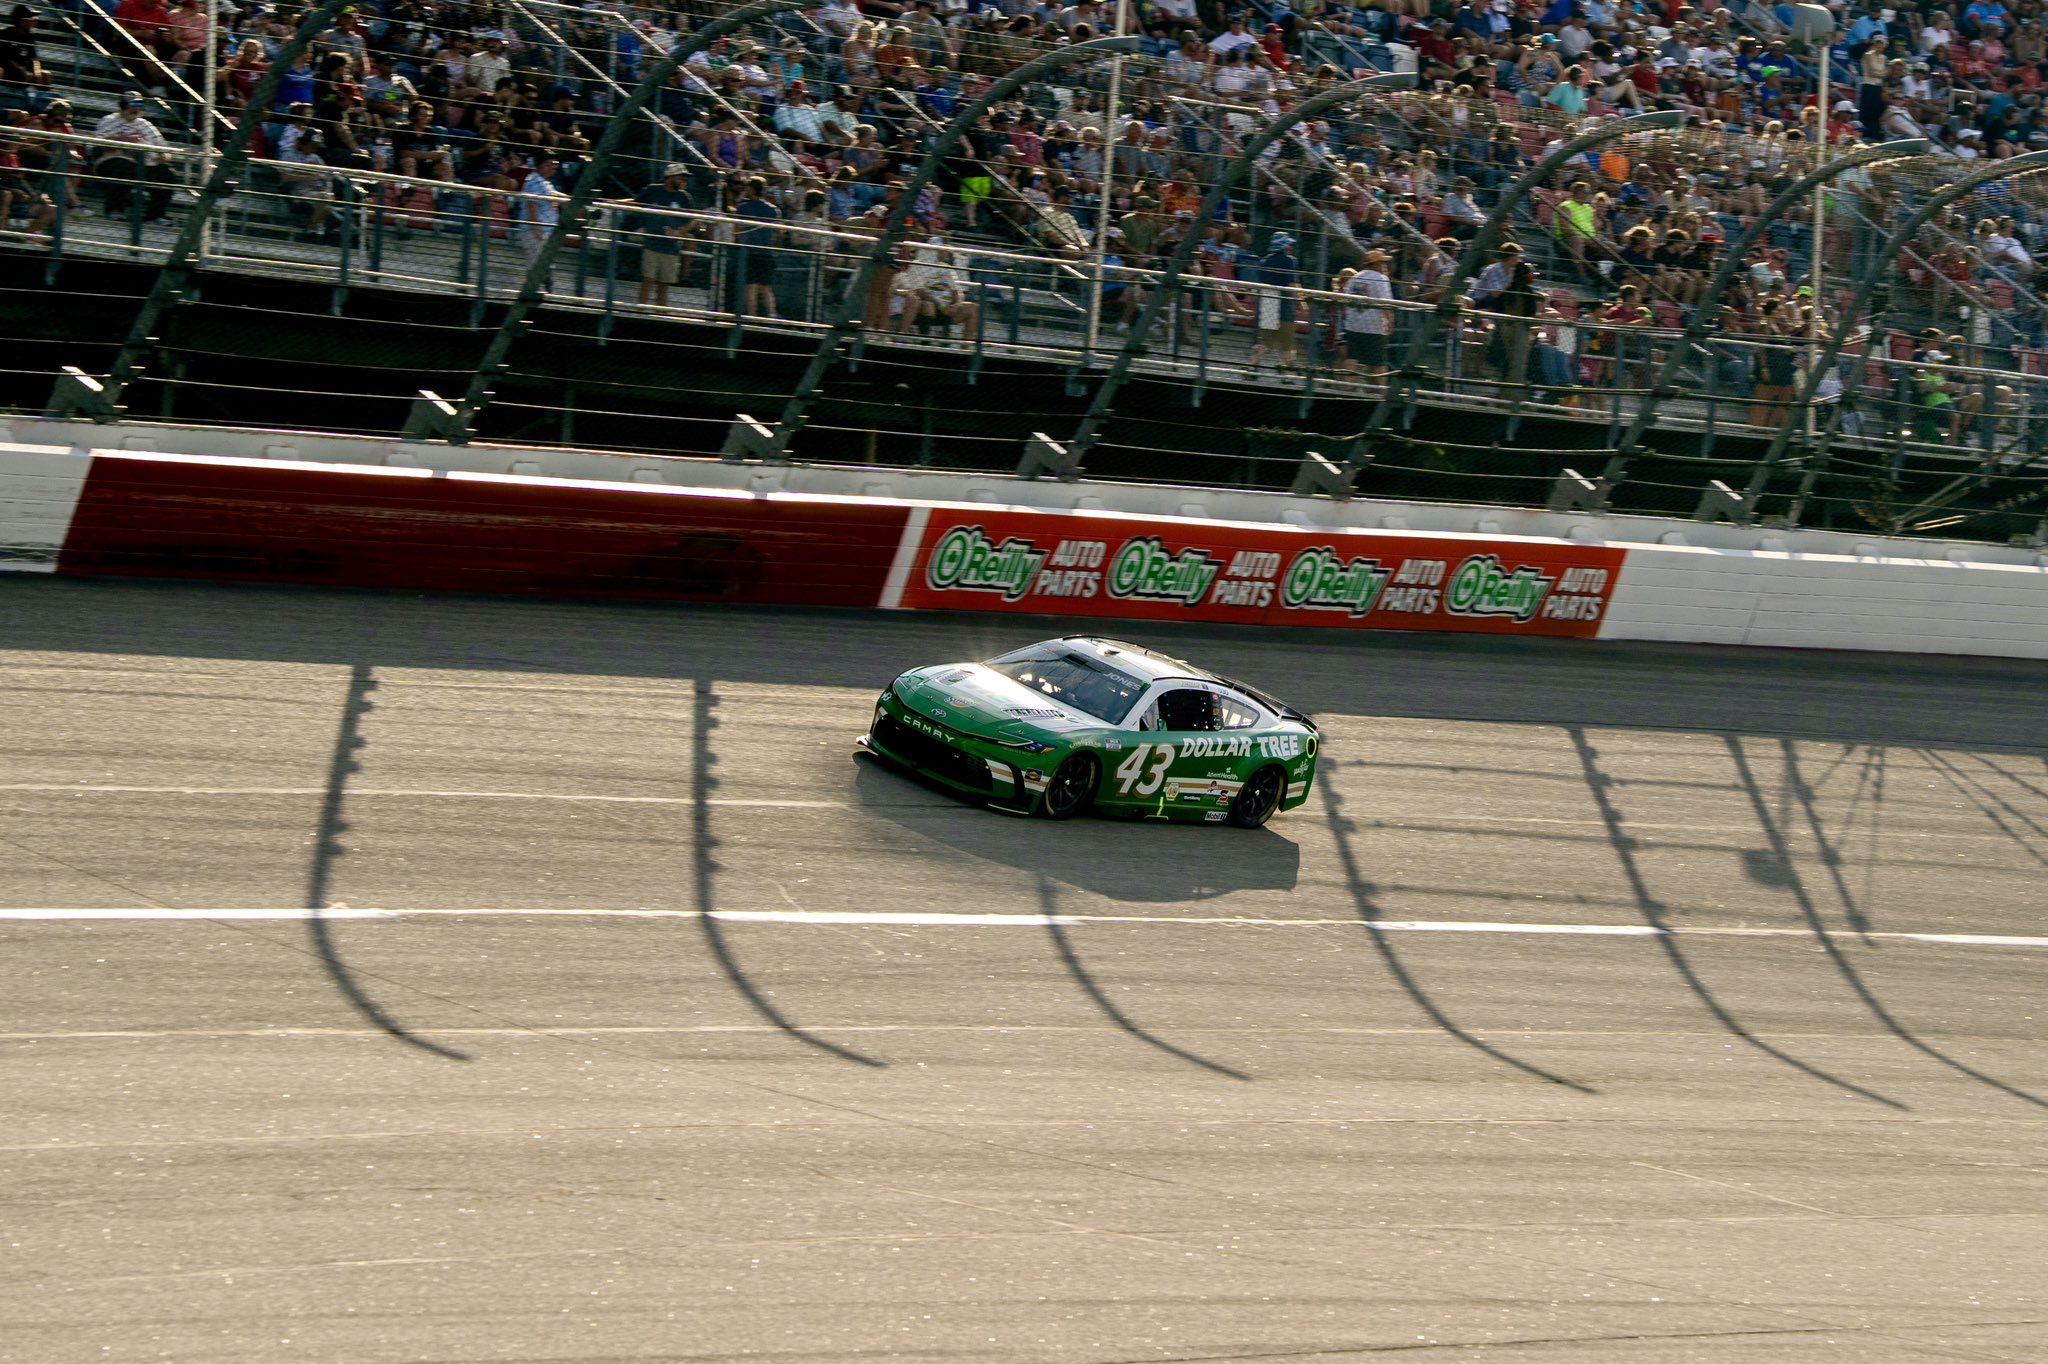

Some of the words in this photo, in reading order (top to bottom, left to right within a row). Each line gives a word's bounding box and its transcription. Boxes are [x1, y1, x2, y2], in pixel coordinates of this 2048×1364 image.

[932, 526, 1046, 599] O'Reilly
[1050, 540, 1107, 568] AUTO
[1225, 551, 1281, 578] AUTO
[1033, 570, 1102, 598] PARTS
[1109, 537, 1221, 605] O'Reilly
[1282, 548, 1389, 615] O'Reilly
[1393, 559, 1447, 586] AUTO
[1556, 568, 1608, 593] AUTO
[1210, 580, 1276, 607] PARTS
[1378, 587, 1441, 614] PARTS
[1447, 556, 1551, 620] O'Reilly
[1541, 595, 1603, 621] PARTS
[1103, 672, 1142, 691] JONES
[903, 715, 955, 742] CAMRY
[1179, 737, 1253, 758] DOLLAR
[1257, 735, 1300, 758] TREE
[1115, 743, 1176, 796] 43
